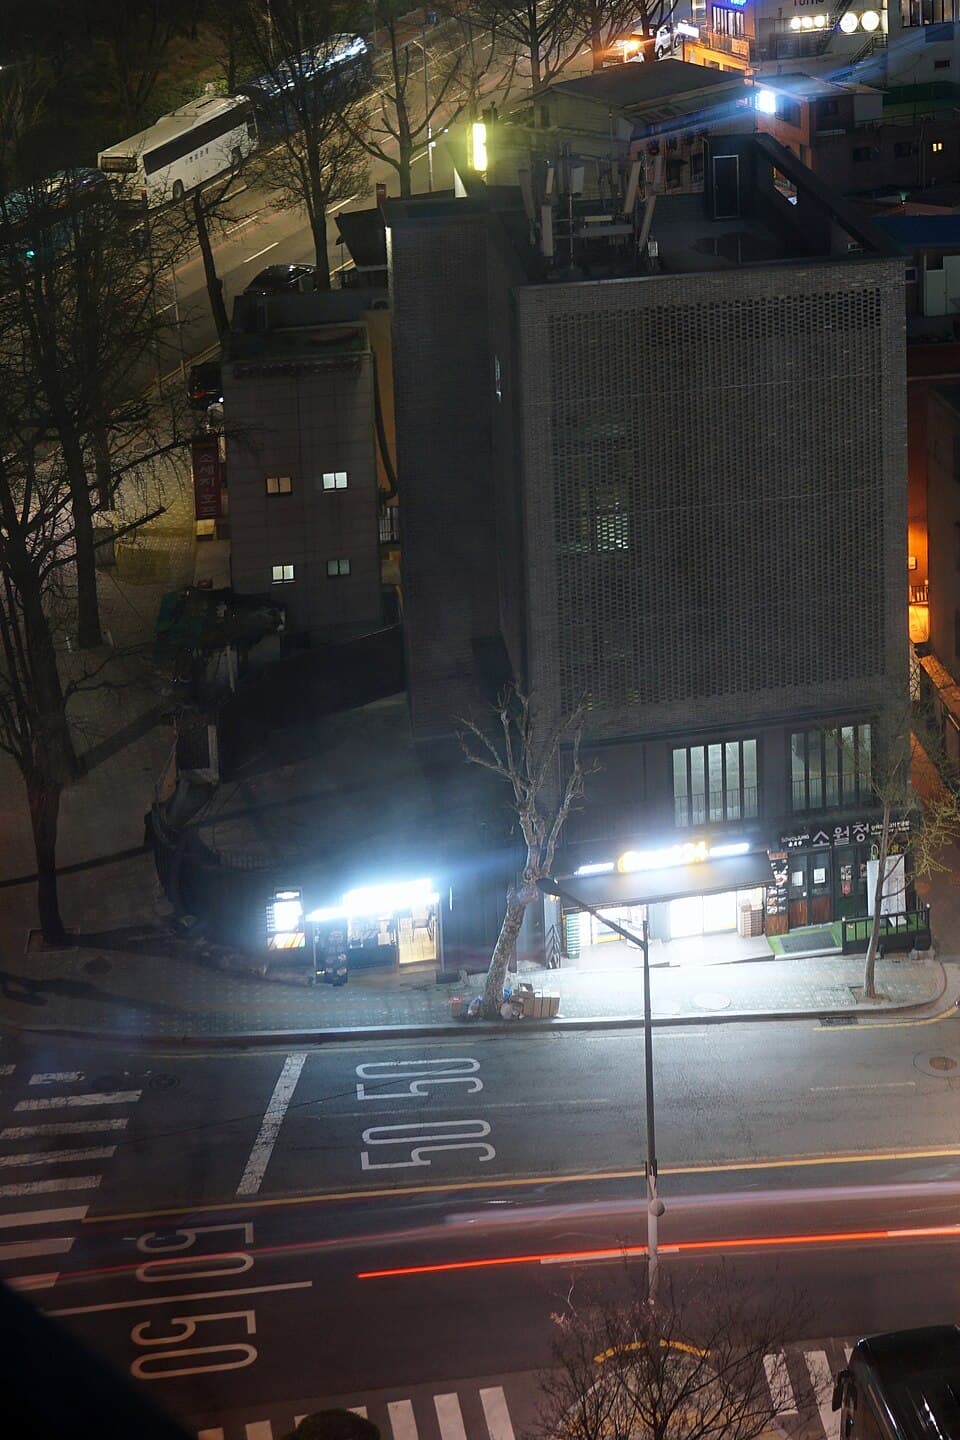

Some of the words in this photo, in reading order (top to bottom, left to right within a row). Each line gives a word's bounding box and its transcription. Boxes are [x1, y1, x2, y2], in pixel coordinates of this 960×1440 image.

[355, 1057, 484, 1101] 50
[361, 1119, 497, 1171] 50
[135, 1222, 255, 1284] 50
[130, 1310, 259, 1381] 50
